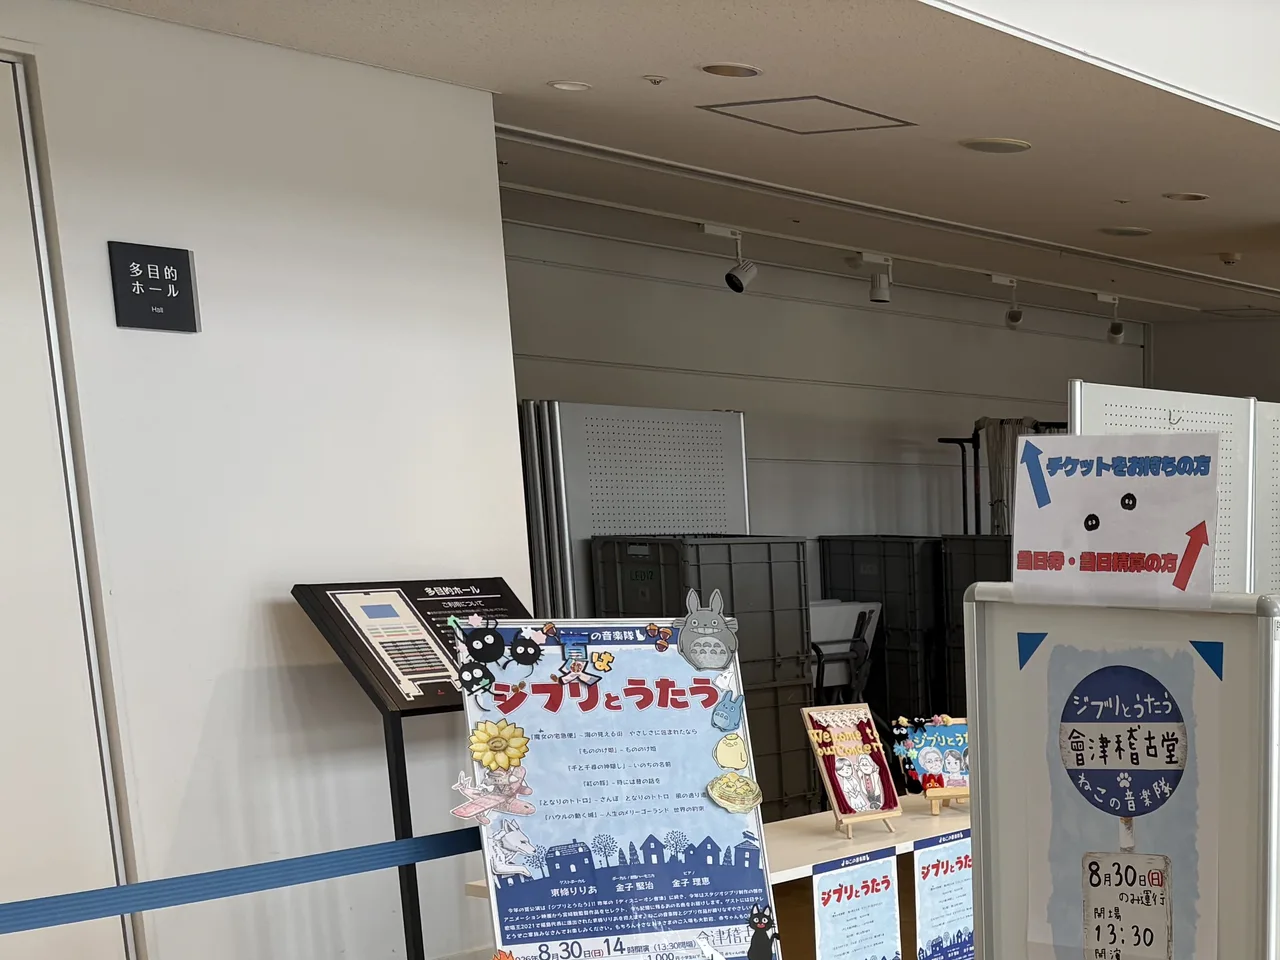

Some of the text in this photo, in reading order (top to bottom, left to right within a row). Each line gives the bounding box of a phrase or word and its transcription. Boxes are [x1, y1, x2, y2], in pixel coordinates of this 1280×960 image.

[129, 261, 178, 281] 多目的
[131, 280, 179, 297] ホール
[1046, 455, 1211, 477] チケットをお持ちの方
[1017, 550, 1179, 573] 当日券・当日精算の方
[424, 586, 480, 596] 多目的ホール
[441, 600, 485, 608] ご利用について
[493, 677, 720, 715] ジブリとうたう
[1073, 691, 1172, 719] ジブリとうたう
[807, 727, 880, 743] Welcome to
[1067, 725, 1179, 766] 會津稽古堂
[625, 793, 669, 802] となりのトトロ
[1078, 772, 1173, 812] ねこの音楽隊
[550, 885, 598, 897] 東條りりあ
[615, 883, 634, 892] 金子
[672, 878, 690, 888] 金子
[821, 875, 891, 907] ジブリとうたう
[1118, 890, 1166, 907] のみ運行
[1094, 906, 1122, 921] 開場
[1095, 923, 1154, 947] 13:30
